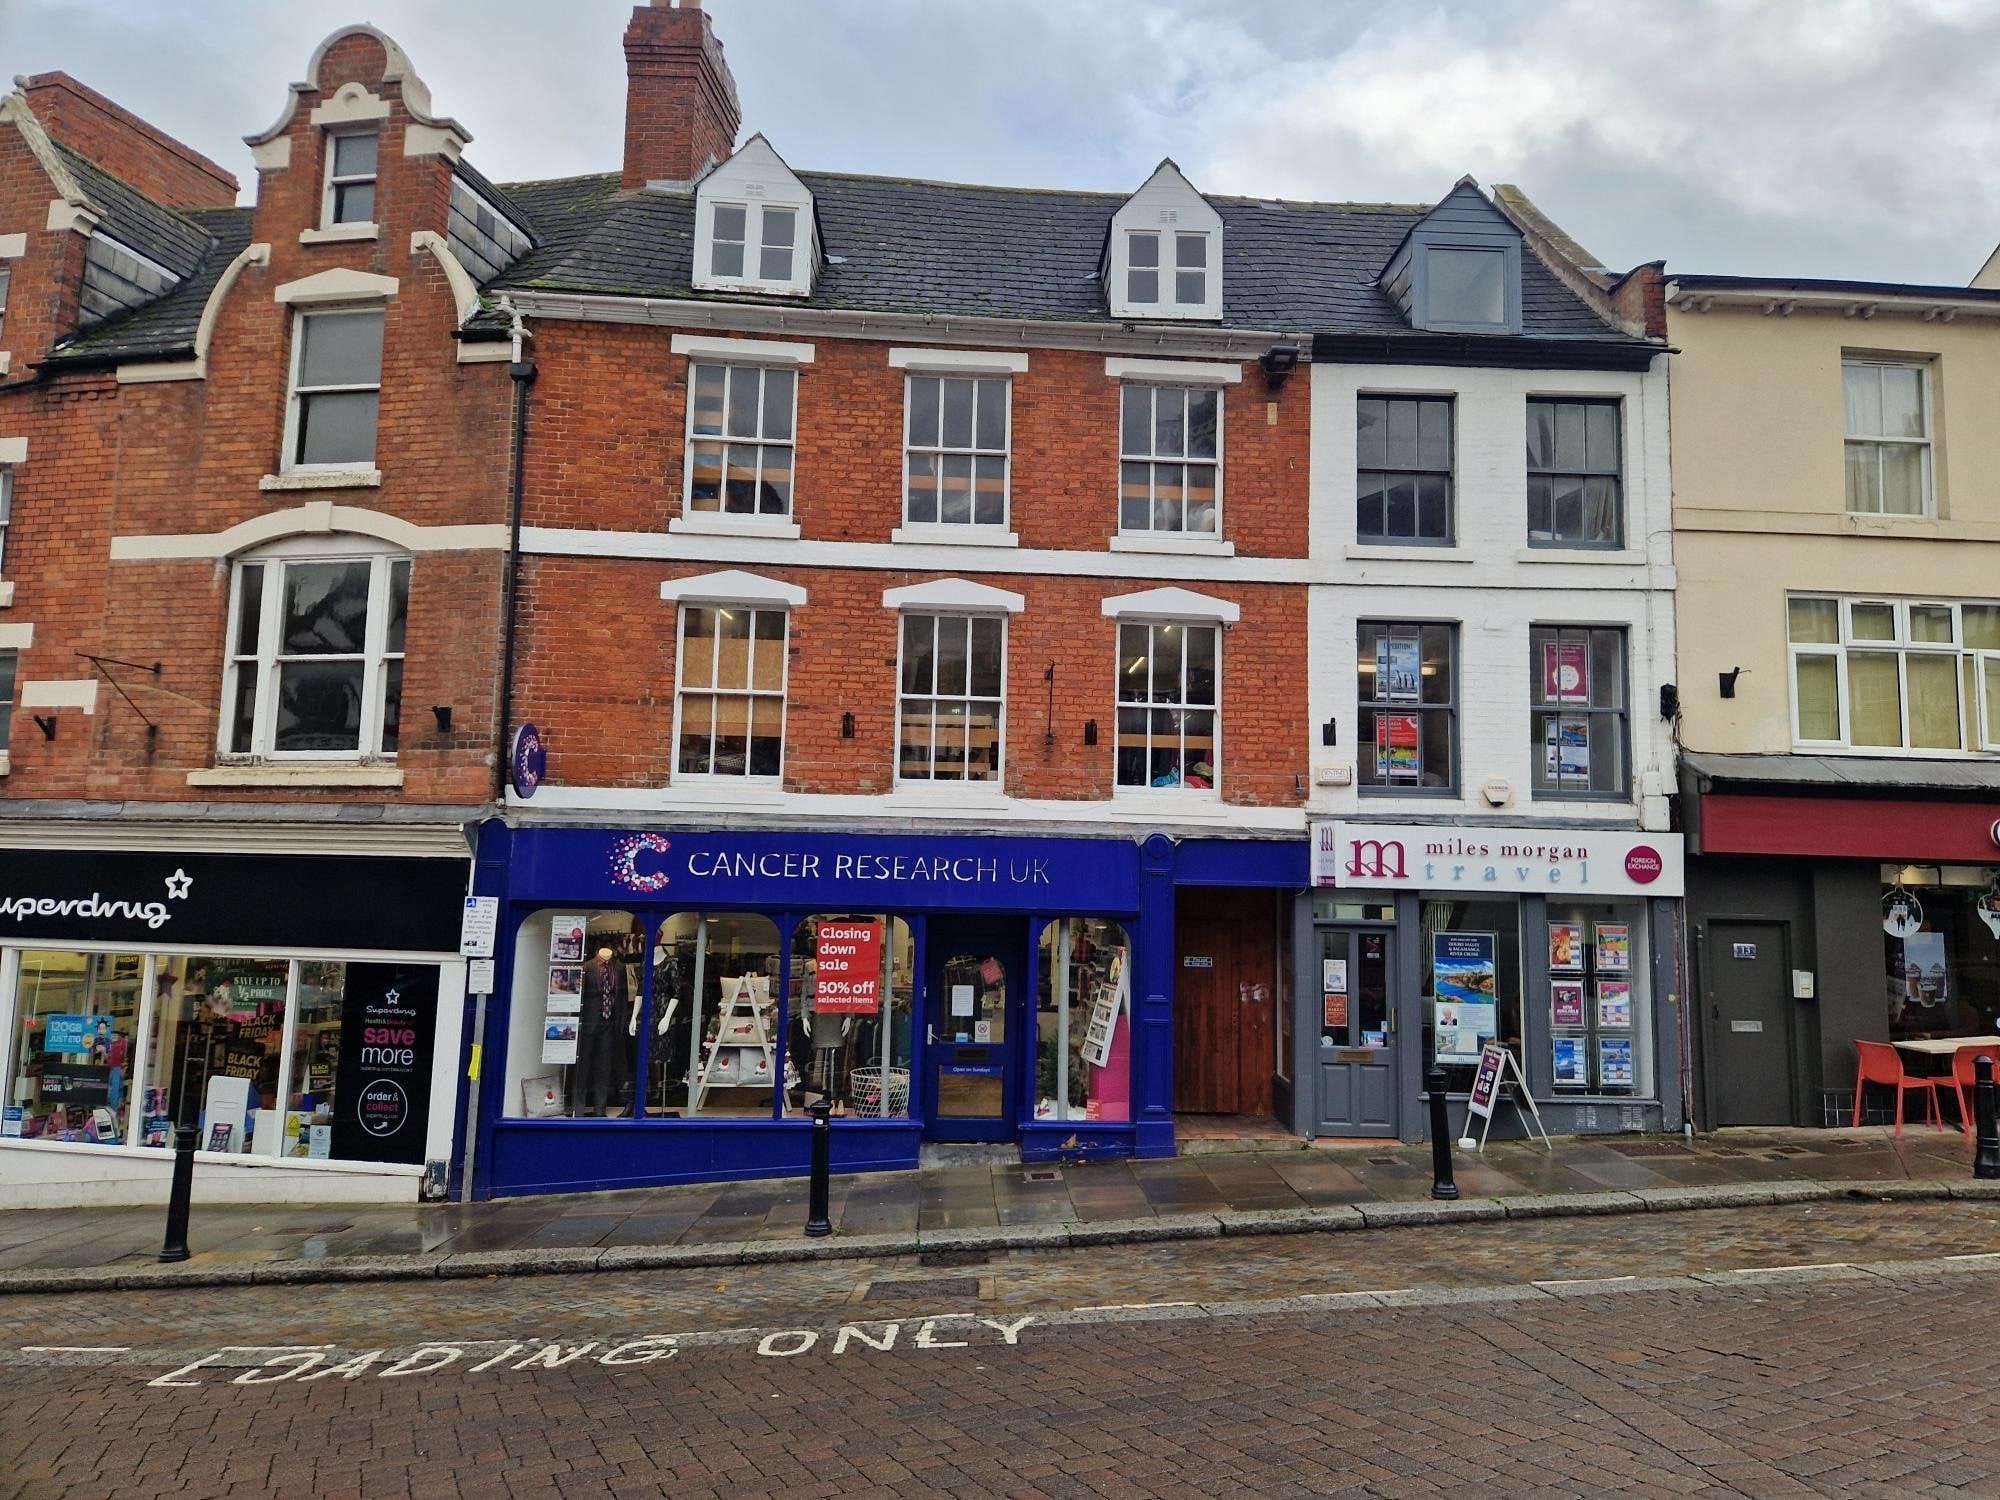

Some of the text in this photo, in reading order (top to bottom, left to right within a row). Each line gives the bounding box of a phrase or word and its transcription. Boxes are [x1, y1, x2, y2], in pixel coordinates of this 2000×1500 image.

[1426, 838, 1589, 863] miles morgan
[688, 852, 1050, 884] CANCER RESEARCH UK
[1425, 861, 1589, 883] travel
[0, 892, 172, 929] uperdrug
[820, 927, 871, 941] Closing
[819, 943, 856, 954] down
[819, 959, 848, 970] sale
[233, 976, 254, 985] SAVE
[269, 977, 281, 986] TO
[818, 981, 875, 994] 50% off
[250, 988, 275, 998] PRICE
[852, 996, 874, 1004] items
[366, 1006, 416, 1016] Superdrug
[50, 1021, 82, 1032] 120GB
[241, 1014, 277, 1027] BLACK
[239, 1026, 274, 1039] FRIDAY
[363, 1027, 416, 1046] save
[227, 1052, 262, 1067] BLACK
[361, 1047, 414, 1065] more
[225, 1065, 260, 1079] FRIDAY
[42, 1084, 62, 1092] MORE
[367, 1092, 399, 1102] order &
[366, 1101, 398, 1112] collect
[147, 1316, 1036, 1387] LOADING ONLY
